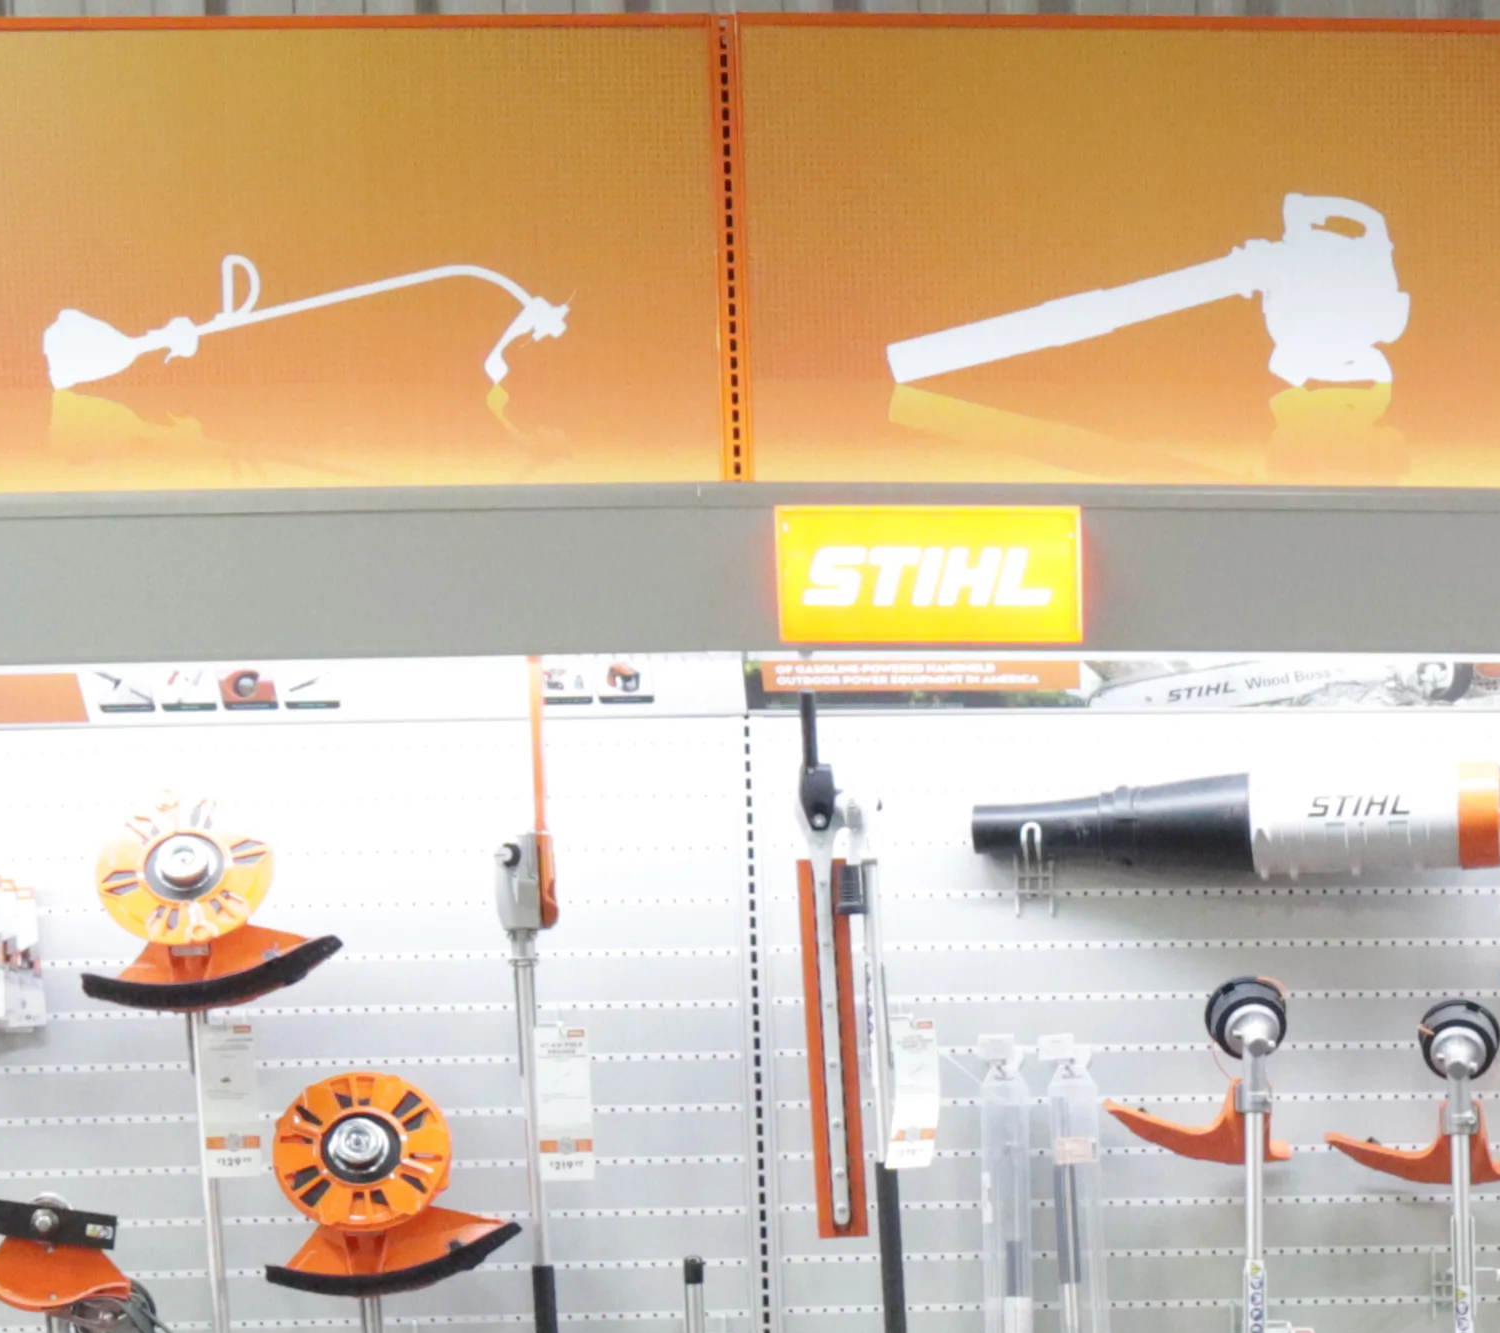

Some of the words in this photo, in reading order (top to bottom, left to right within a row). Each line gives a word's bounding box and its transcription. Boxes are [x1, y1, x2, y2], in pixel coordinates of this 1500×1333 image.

[803, 545, 1053, 607] STIHL
[842, 675, 887, 685] POWER
[1167, 682, 1235, 703] STIHL
[1244, 673, 1290, 691] Wood
[1294, 669, 1332, 684] Boss
[1307, 794, 1411, 818] STIHL
